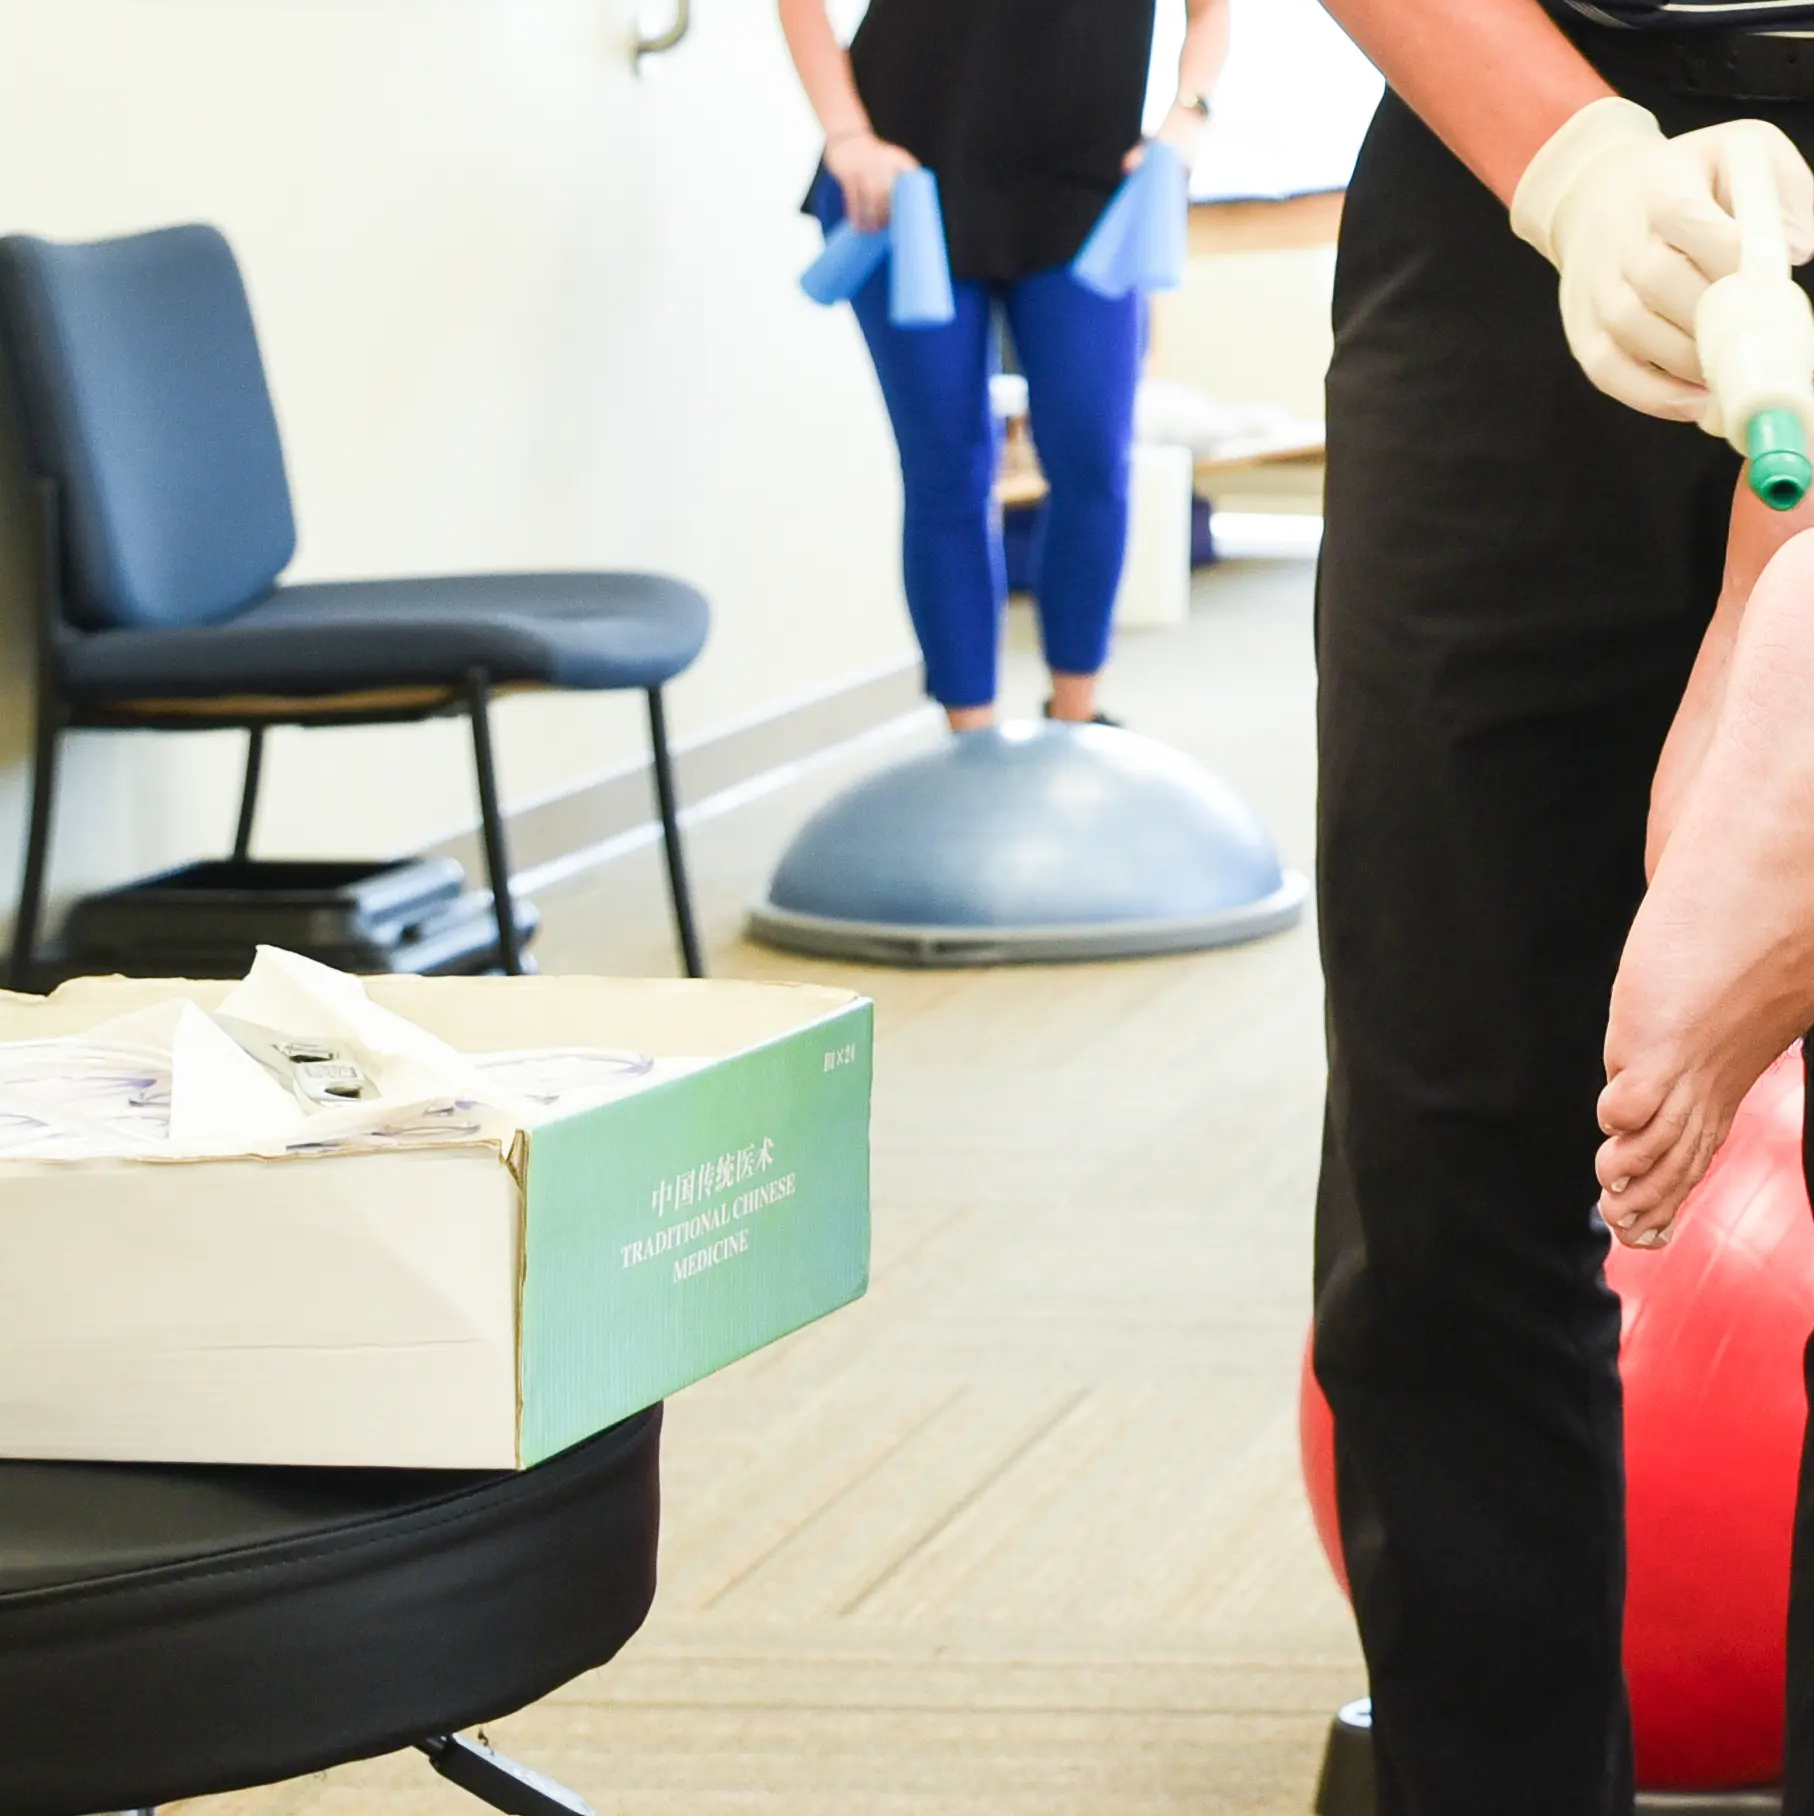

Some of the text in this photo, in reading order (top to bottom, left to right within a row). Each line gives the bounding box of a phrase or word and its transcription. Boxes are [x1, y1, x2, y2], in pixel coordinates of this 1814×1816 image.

[651, 1136, 775, 1218] 中国传统医术
[620, 1172, 797, 1269] TRADITIONAL CHINESE
[673, 1228, 749, 1284] MEDICINE
